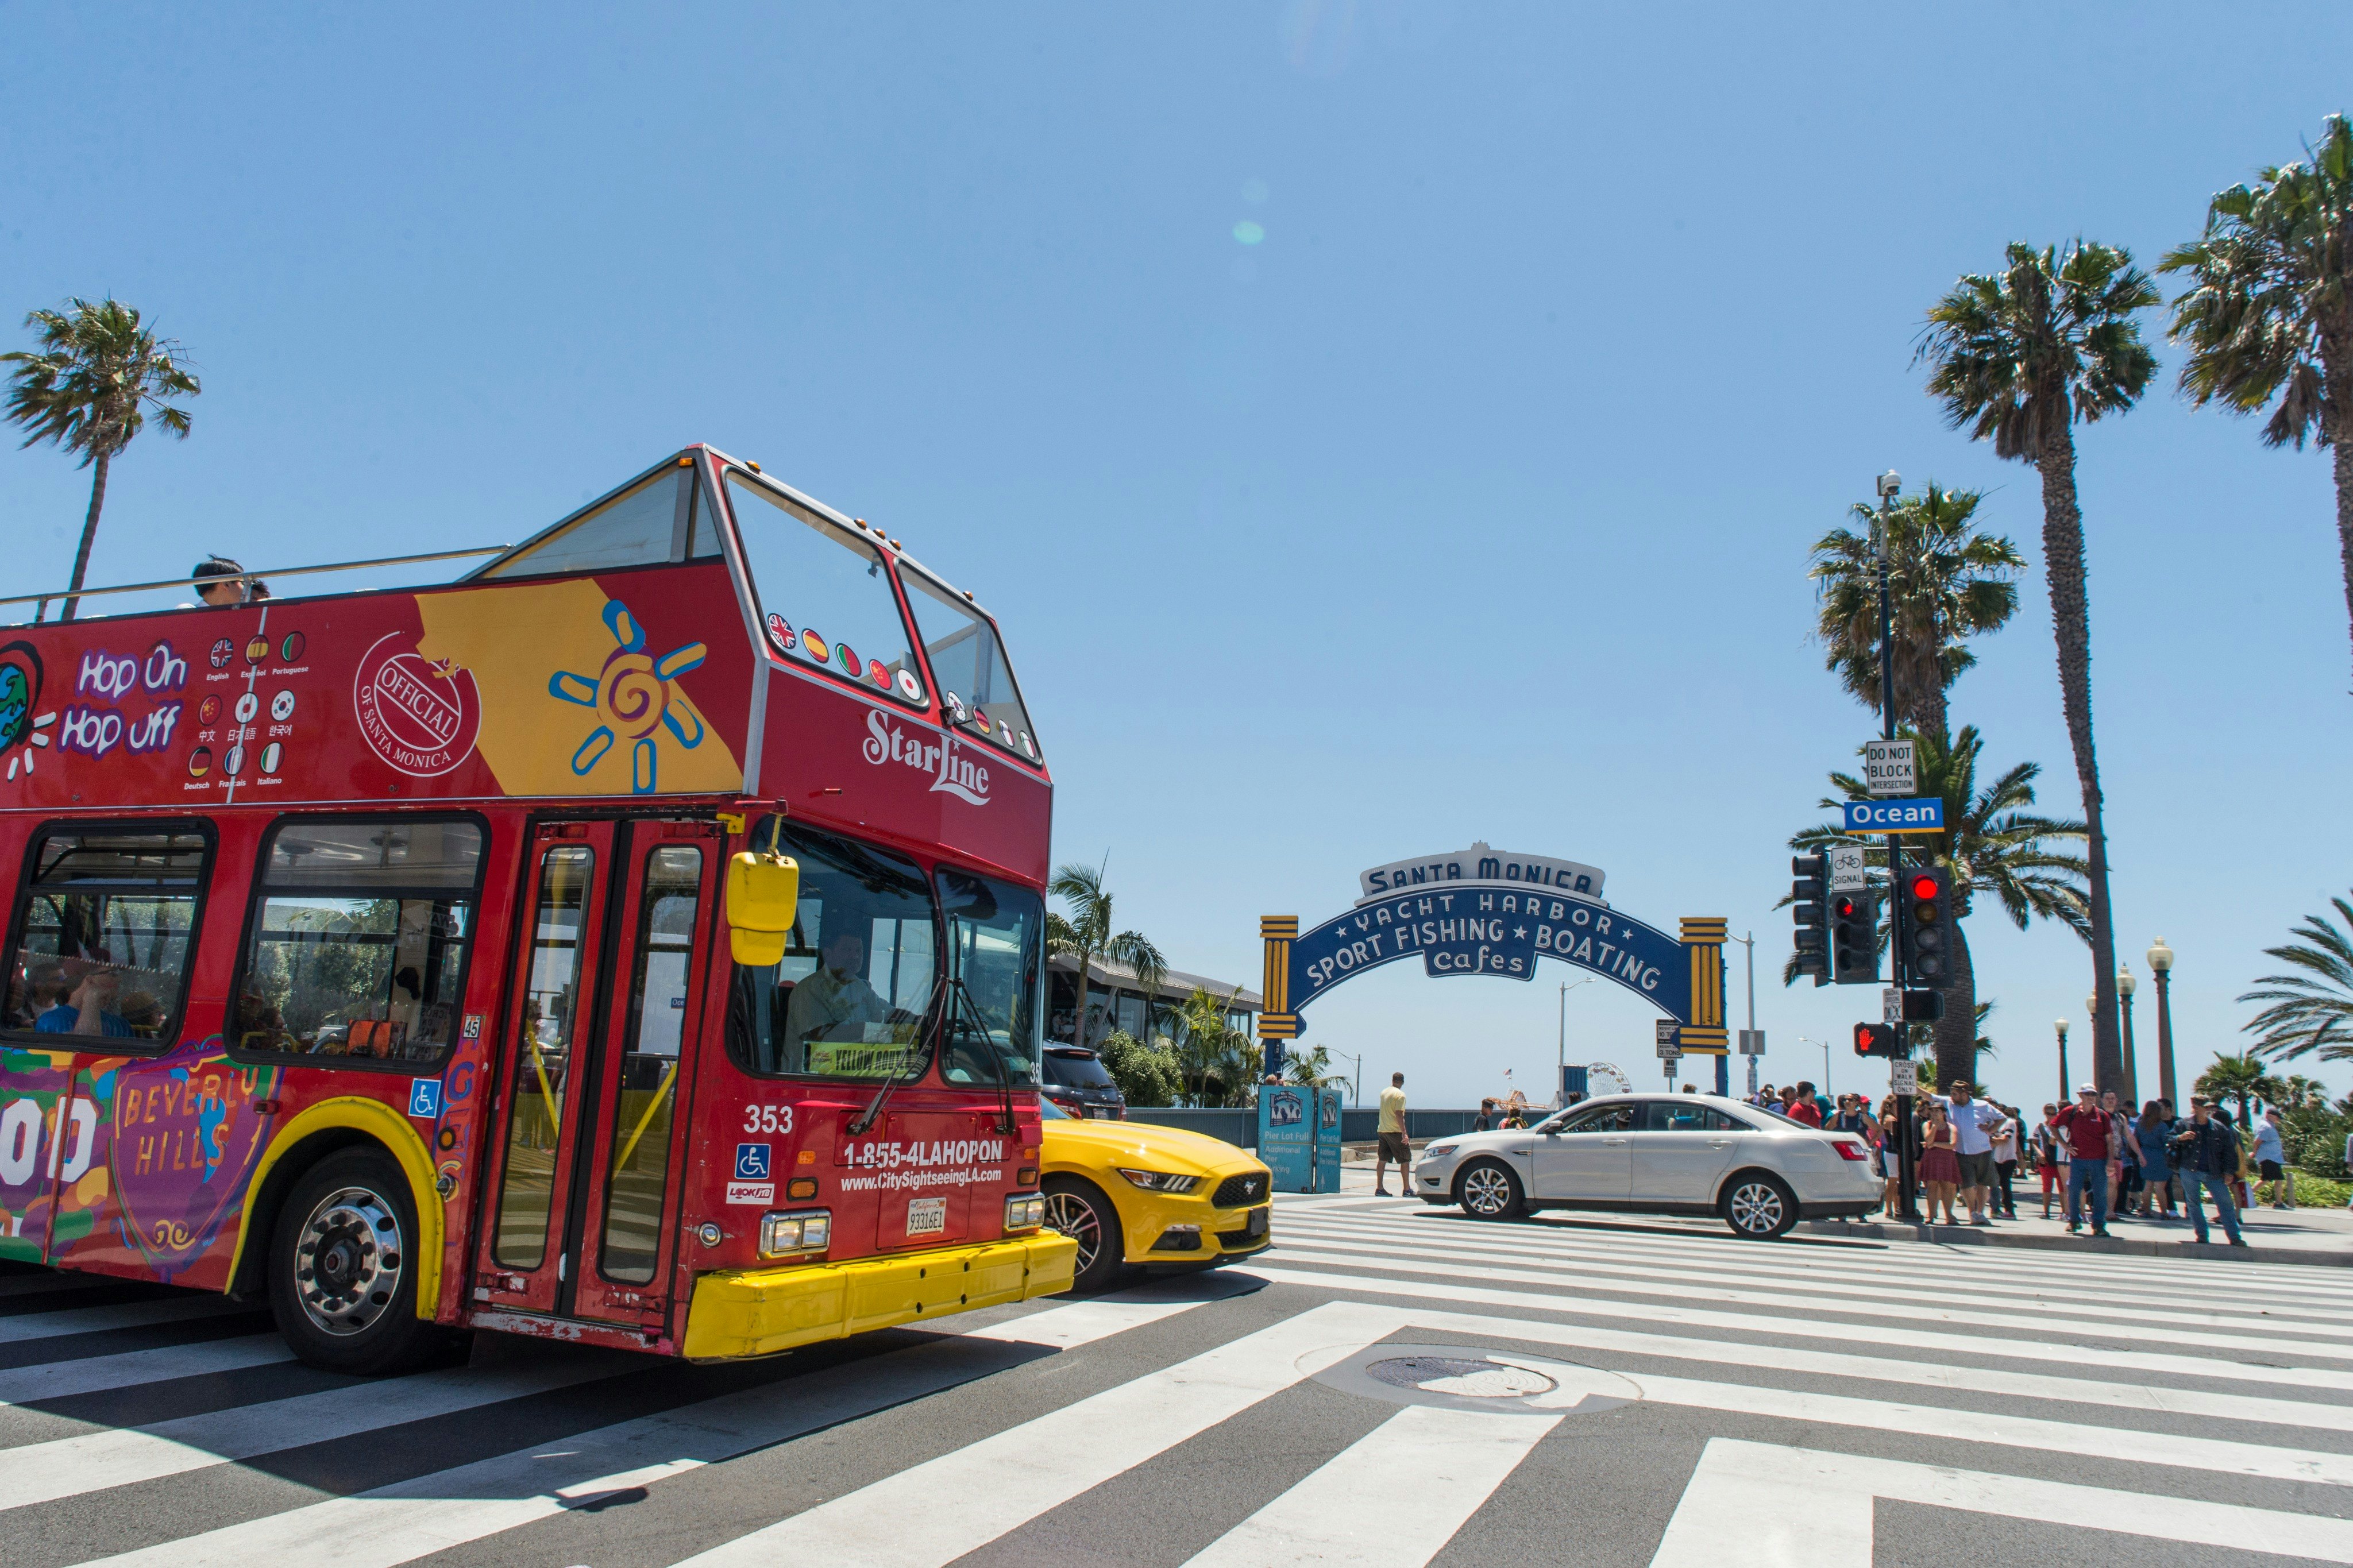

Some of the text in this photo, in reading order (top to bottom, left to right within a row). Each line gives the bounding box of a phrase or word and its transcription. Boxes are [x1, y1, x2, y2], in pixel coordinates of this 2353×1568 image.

[79, 644, 186, 698] Hop On
[206, 673, 229, 682] English
[272, 667, 309, 675] Portuguese
[381, 667, 453, 738] OFFICIAL
[62, 710, 121, 754] Hop
[199, 729, 216, 742] 中文
[269, 724, 292, 736] 한국어
[361, 685, 452, 768] OF SANTA MONICA
[1870, 747, 1911, 760] DO NOT
[1870, 764, 1911, 778] BLOCK
[184, 782, 210, 790] Deutsch
[257, 777, 282, 786] Italiano
[1870, 779, 1913, 790] INTERSECTION
[1852, 805, 1935, 824] Ocean
[1368, 858, 1591, 895] SANTA MONICA
[1834, 874, 1862, 885] SIGNAL
[1354, 894, 1611, 935] YACHT HARBOR
[1306, 918, 1661, 991] SPORT FISHING BOATING
[465, 1021, 479, 1037] 45
[836, 1049, 874, 1071] YELLOW
[125, 1067, 259, 1127] BEVERLY
[743, 1104, 793, 1134] 353
[1265, 1131, 1309, 1141] Pier Lot Full
[135, 1123, 230, 1176] HILLS
[844, 1140, 1003, 1170] 1-855-4LAHOPON
[1265, 1145, 1301, 1154] Additional
[841, 1167, 1002, 1191] www.CitySightseeingLA.com
[910, 1211, 943, 1231] 93316E1
